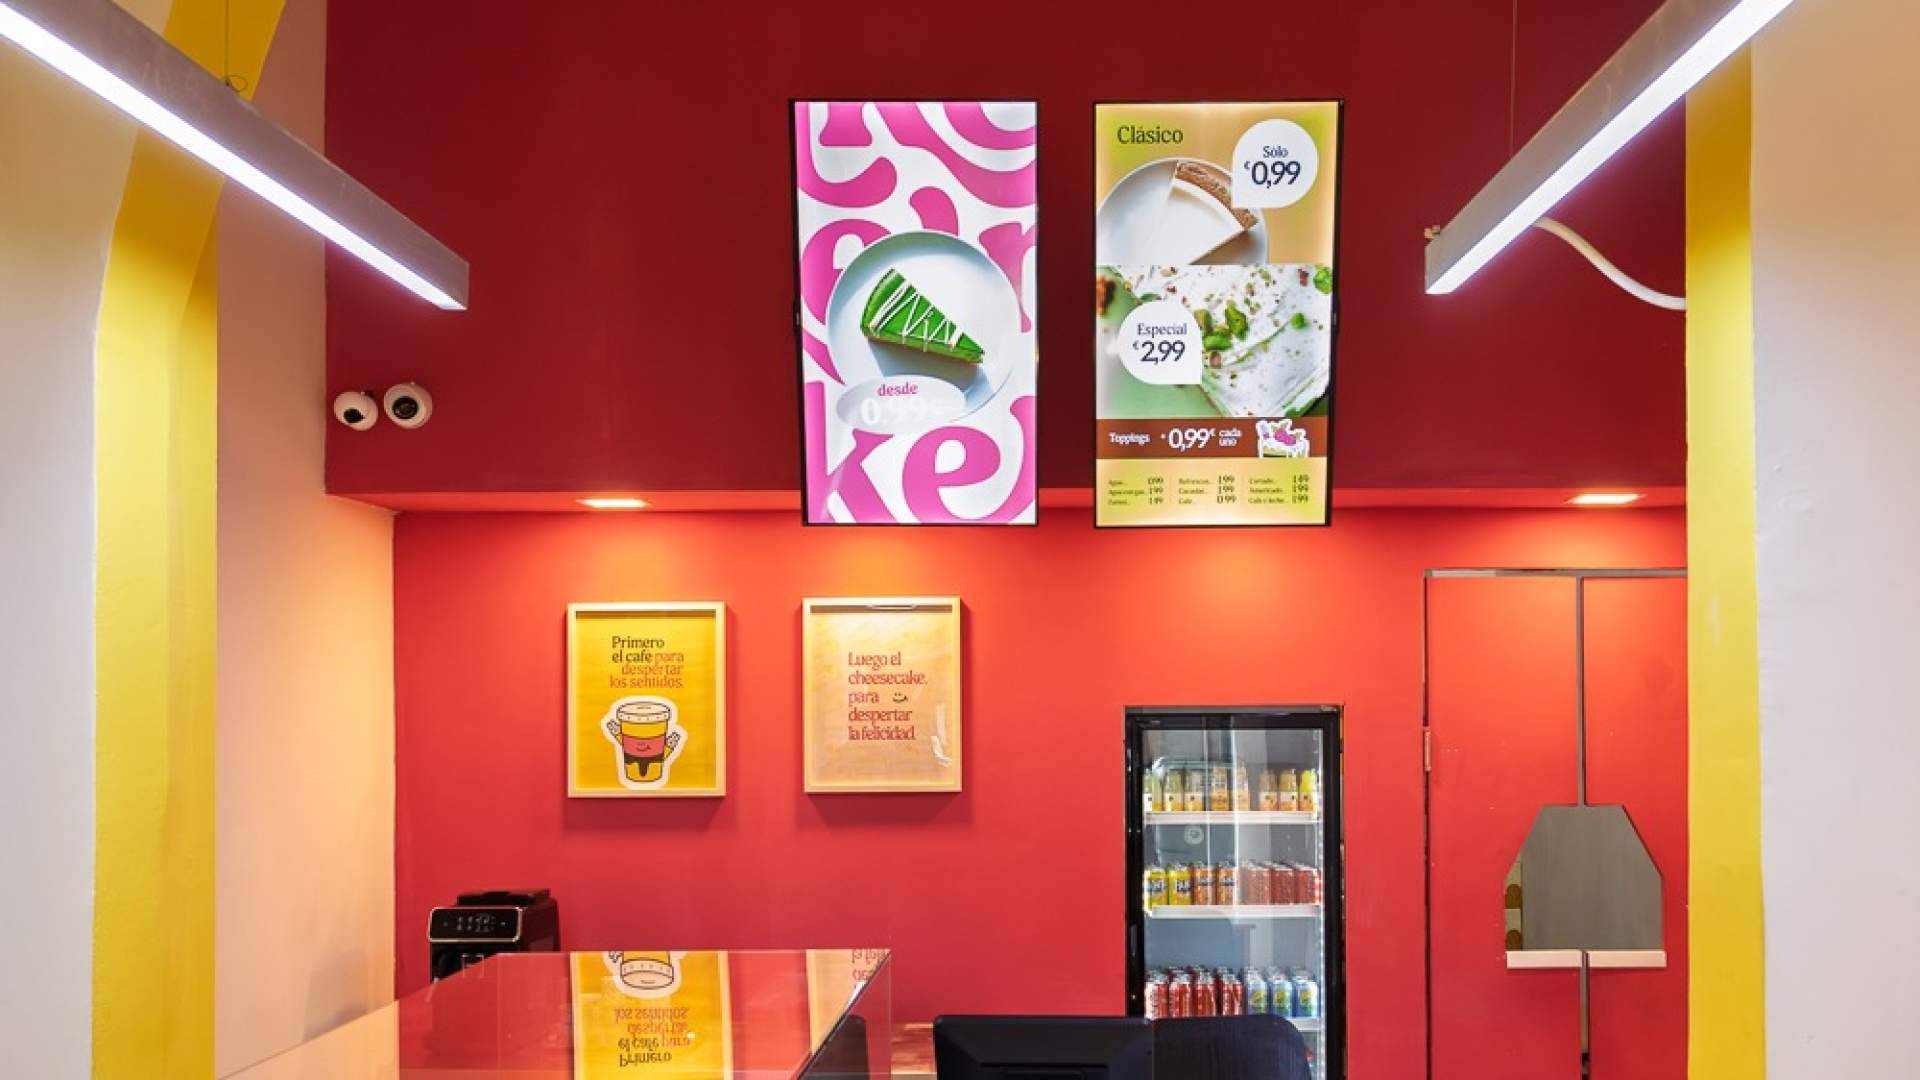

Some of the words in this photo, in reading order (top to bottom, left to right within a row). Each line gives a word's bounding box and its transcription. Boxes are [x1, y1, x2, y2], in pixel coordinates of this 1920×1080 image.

[1117, 124, 1184, 145] Clásico
[1136, 322, 1187, 340] Especial
[877, 381, 918, 397] desde
[1218, 427, 1242, 438] cada
[611, 635, 665, 649] Primero
[611, 650, 623, 663] el
[847, 651, 888, 670] Luego
[890, 651, 902, 666] el
[621, 662, 685, 678] despertar
[609, 674, 627, 688] los
[847, 689, 880, 706] para
[847, 706, 913, 725] despertar
[847, 726, 861, 741] la
